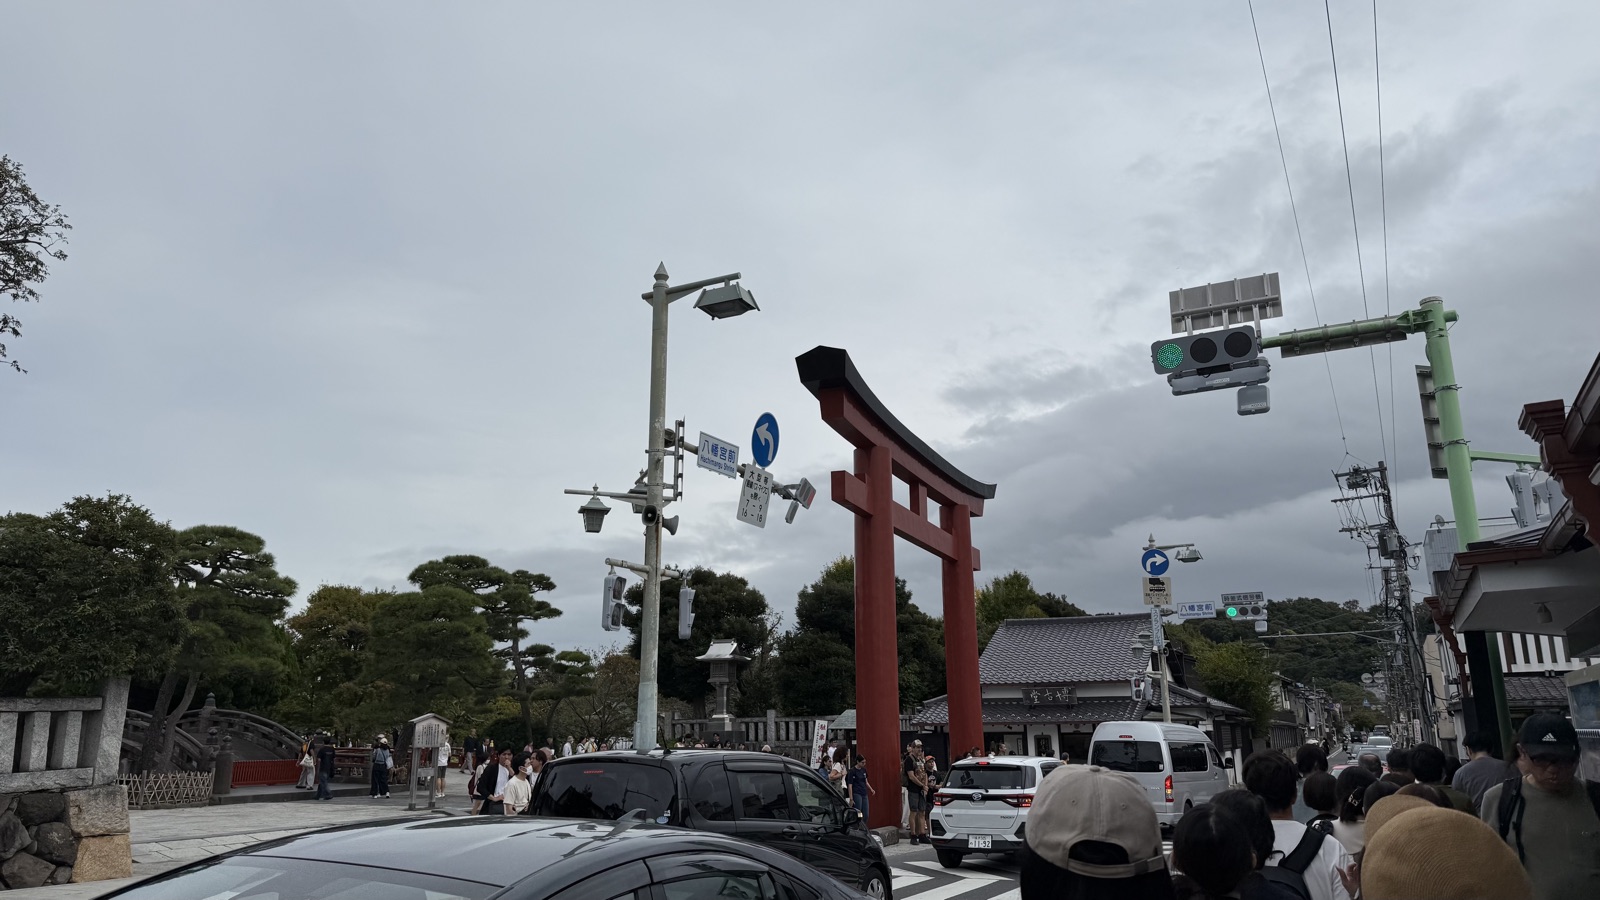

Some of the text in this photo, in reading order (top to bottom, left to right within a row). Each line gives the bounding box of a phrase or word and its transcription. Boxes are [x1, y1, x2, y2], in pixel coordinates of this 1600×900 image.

[702, 439, 736, 464] 八幡宮前
[700, 455, 735, 474] Hachimangu Shrine
[1180, 603, 1213, 612] 八幡宮前
